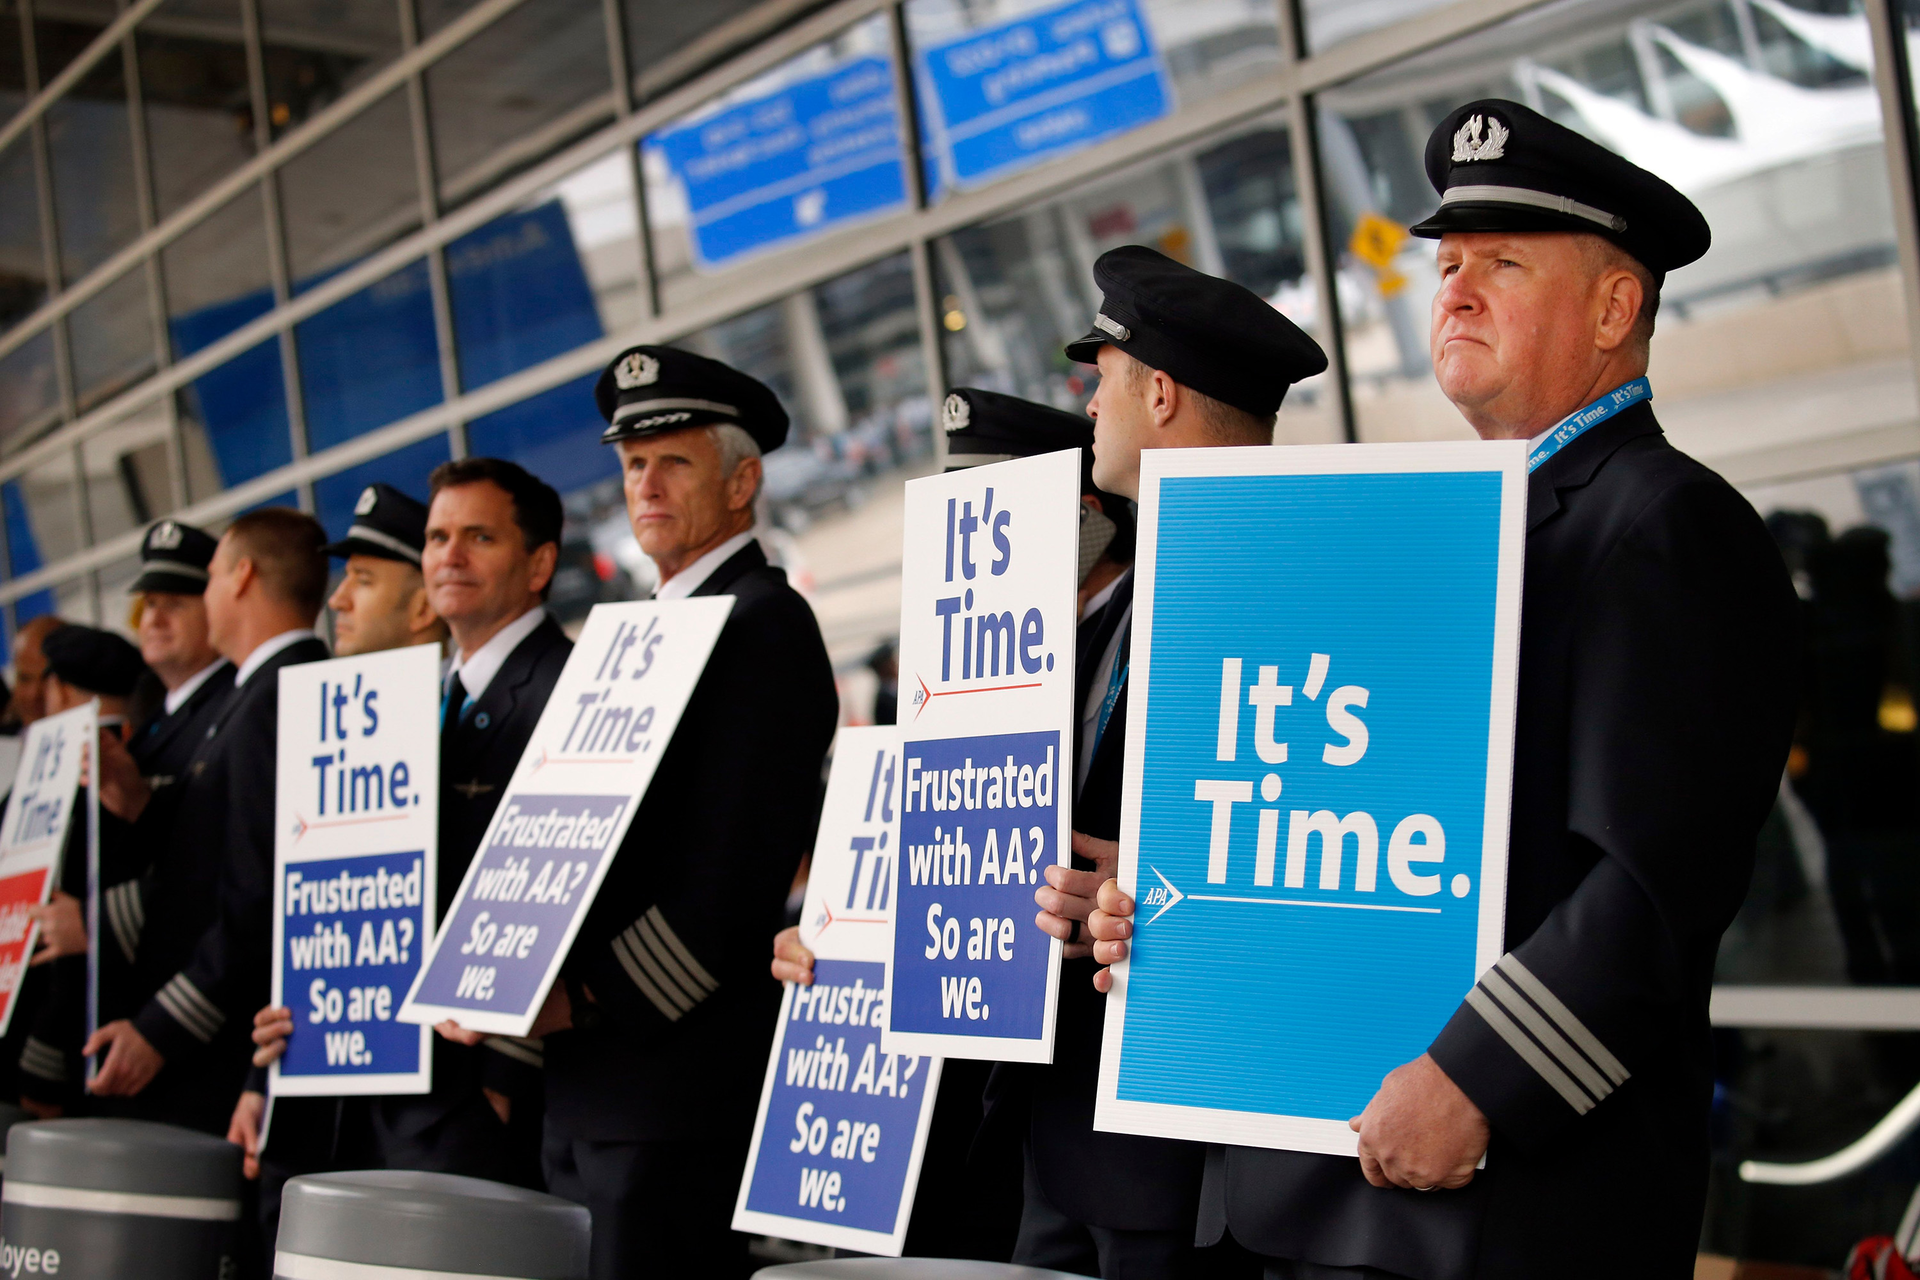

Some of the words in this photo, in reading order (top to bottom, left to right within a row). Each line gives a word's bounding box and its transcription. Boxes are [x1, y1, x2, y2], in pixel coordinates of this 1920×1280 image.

[1528, 450, 1550, 468] me.
[1553, 425, 1577, 444] It's
[1573, 405, 1608, 427] Time.
[945, 487, 1011, 582] It's
[595, 616, 664, 681] It's
[935, 588, 1055, 682] Time.
[320, 673, 379, 742] It's
[560, 687, 655, 753] Time.
[1216, 652, 1370, 766] It's
[311, 748, 420, 817] Time.
[863, 749, 896, 823] It
[905, 745, 1054, 813] Frustrated
[491, 804, 624, 850] Frustrated
[908, 825, 972, 886] with
[978, 826, 1044, 885] AA?
[1194, 773, 1471, 898] Time.
[285, 858, 423, 916] Frustrated
[472, 856, 530, 902] with
[523, 860, 589, 905] AA?
[1142, 888, 1168, 906] APA
[290, 921, 350, 970] with
[355, 917, 415, 966] AA?
[460, 911, 498, 956] So
[492, 923, 539, 959] are
[924, 902, 961, 961] So
[967, 916, 1015, 962] are
[309, 978, 344, 1024] So
[347, 985, 393, 1022] are
[455, 964, 497, 1001] we.
[790, 978, 884, 1028] Frustra
[940, 976, 990, 1021] we.
[325, 1030, 373, 1067] we.
[785, 1034, 850, 1091] with
[850, 1043, 920, 1099] AA?
[789, 1101, 829, 1156] So
[831, 1119, 881, 1163] are
[798, 1167, 846, 1213] we.
[0, 1236, 60, 1279] loyee
